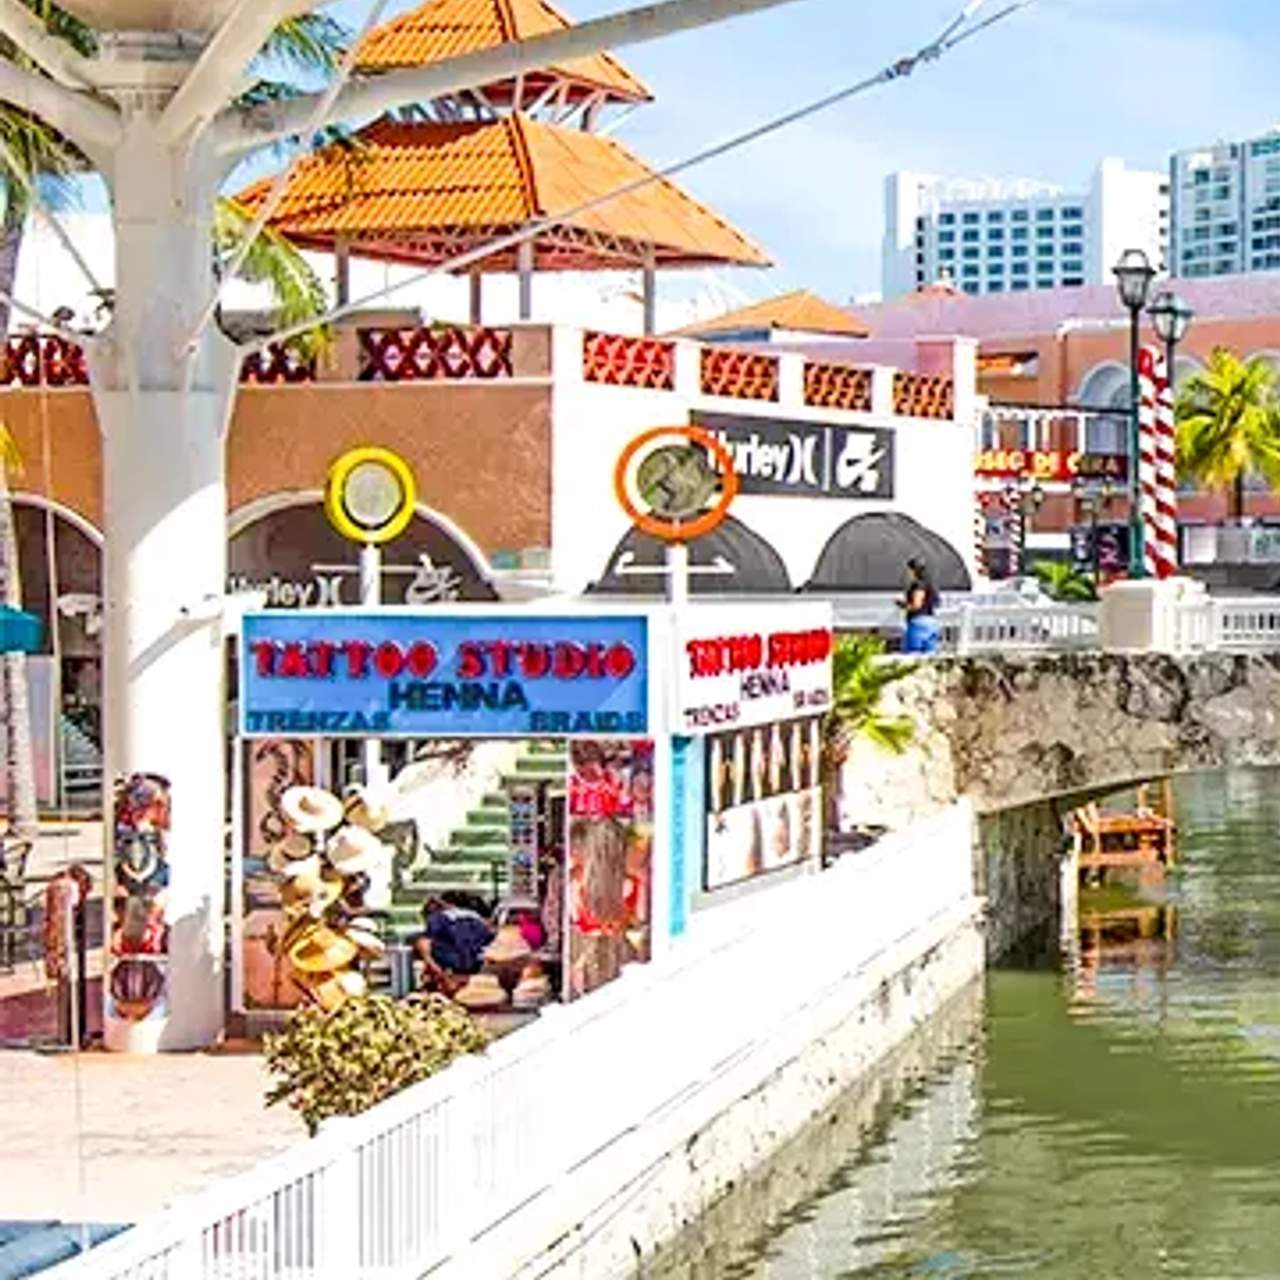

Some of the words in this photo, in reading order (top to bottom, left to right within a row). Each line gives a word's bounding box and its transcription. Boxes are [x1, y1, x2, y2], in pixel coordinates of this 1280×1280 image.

[250, 638, 439, 680] TATTOO
[455, 638, 637, 680] STUDIO
[388, 681, 529, 711] HENNA
[247, 710, 392, 732] TRENZAS
